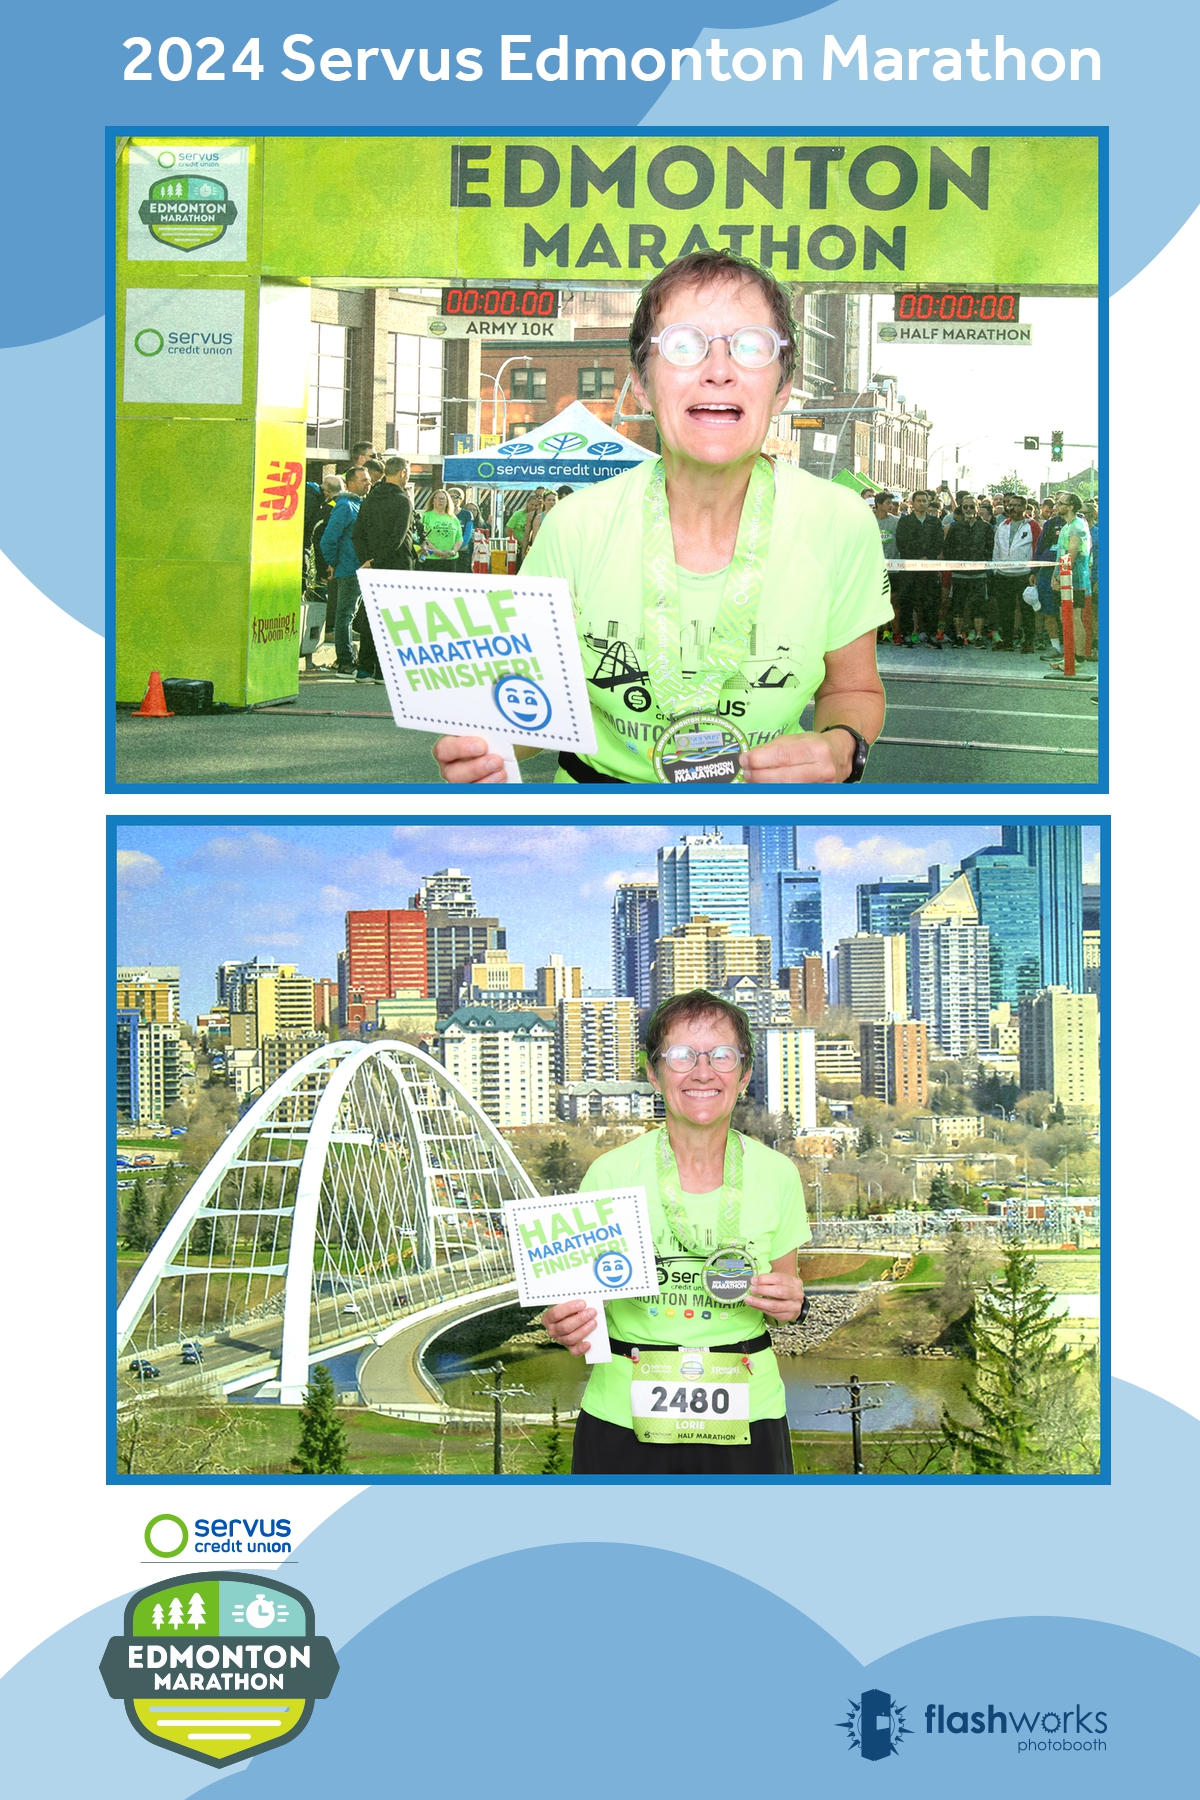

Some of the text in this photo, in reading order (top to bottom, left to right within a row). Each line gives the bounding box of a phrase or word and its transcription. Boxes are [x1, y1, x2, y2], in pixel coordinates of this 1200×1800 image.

[178, 152, 219, 161] servus
[450, 144, 991, 211] EDMONTON
[149, 203, 227, 214] EDMONTON
[160, 214, 215, 222] MARATHON
[523, 223, 907, 271] MARATHON
[168, 331, 233, 345] servus
[466, 321, 554, 336] ARMY 10K
[900, 328, 1031, 341] HALF MARATHON
[167, 345, 233, 355] credit union
[496, 465, 546, 476] servus
[548, 463, 590, 476] credit
[257, 613, 291, 636] Running
[380, 589, 517, 647] HALF
[397, 633, 533, 667] MARATHON
[404, 656, 545, 692] FINISHER!
[668, 717, 700, 735] EDMONTON
[701, 716, 733, 731] MARATHON
[674, 765, 735, 784] MARATHON
[517, 1196, 614, 1249] HALF
[527, 1222, 623, 1262] MARATHON
[531, 1237, 629, 1279] FINISHER!
[671, 1271, 700, 1284] ser
[650, 1385, 730, 1415] 2480
[675, 1420, 706, 1430] LORIE
[677, 1432, 694, 1440] HALF
[695, 1433, 736, 1441] MARATHON
